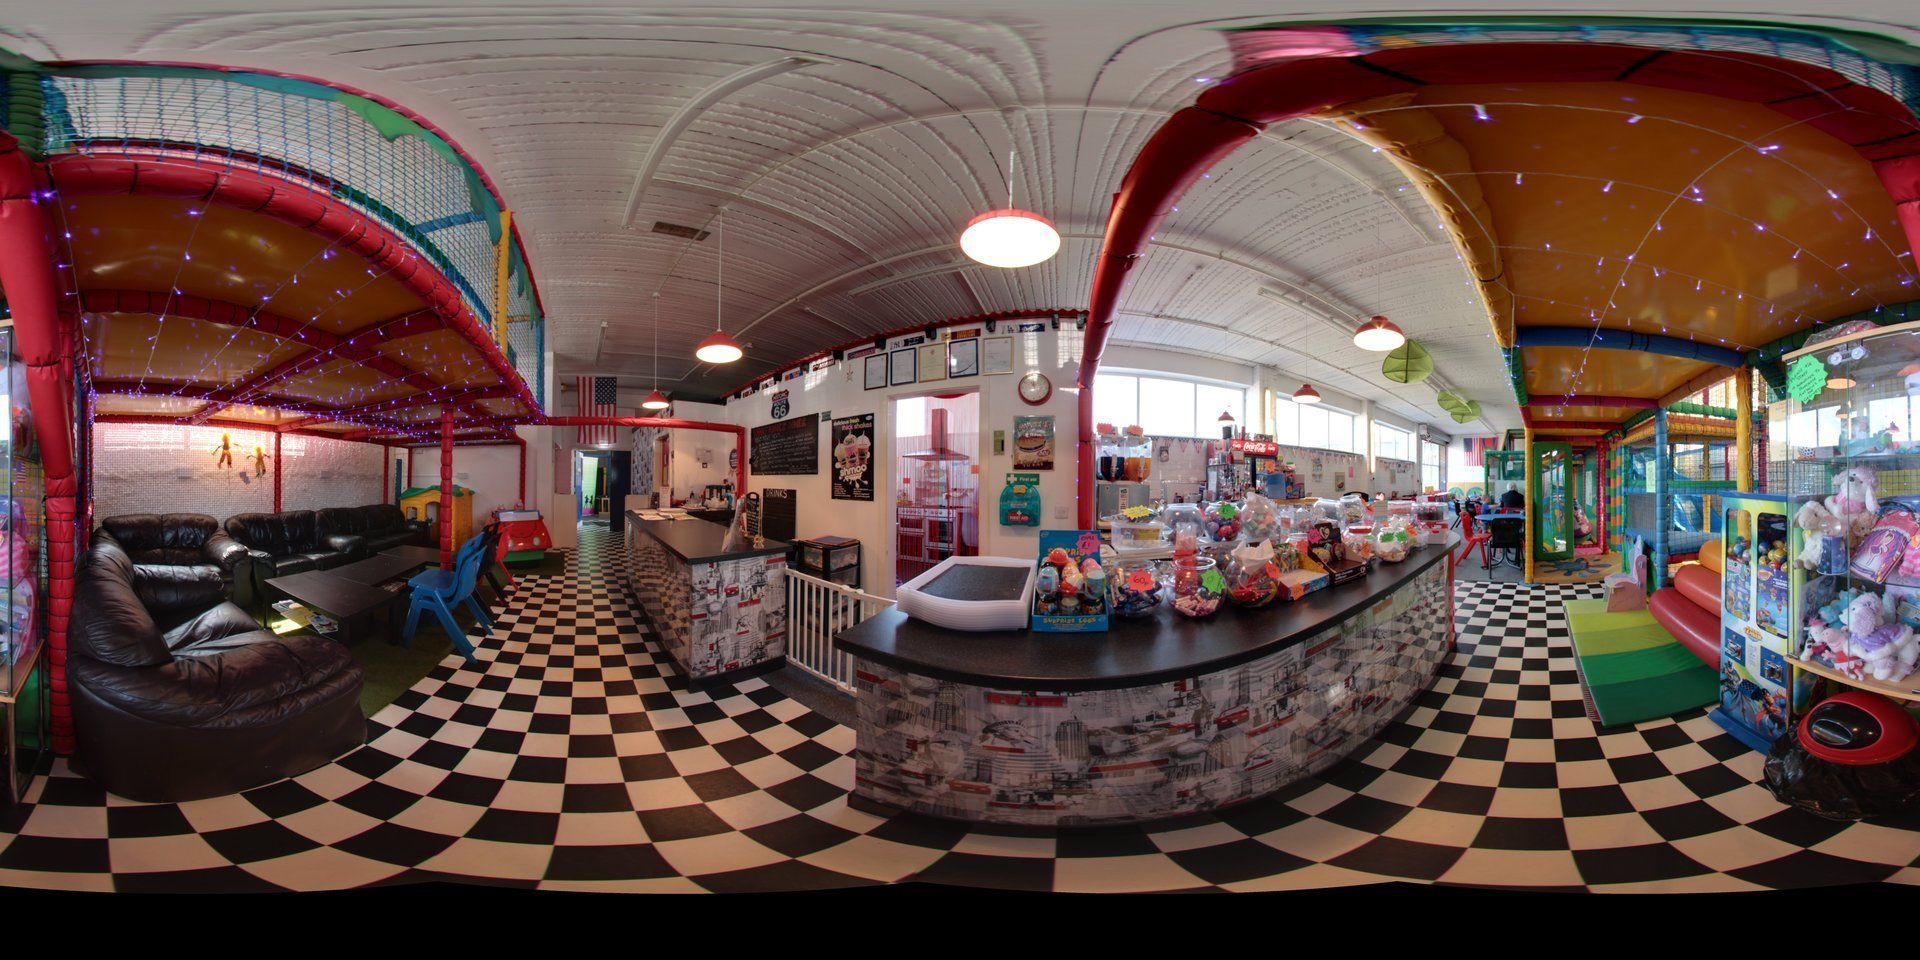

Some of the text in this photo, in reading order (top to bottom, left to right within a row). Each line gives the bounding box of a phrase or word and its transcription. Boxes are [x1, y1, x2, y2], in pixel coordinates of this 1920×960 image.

[774, 404, 787, 418] 66
[840, 464, 867, 477] shmoo
[766, 488, 788, 498] DRINKS
